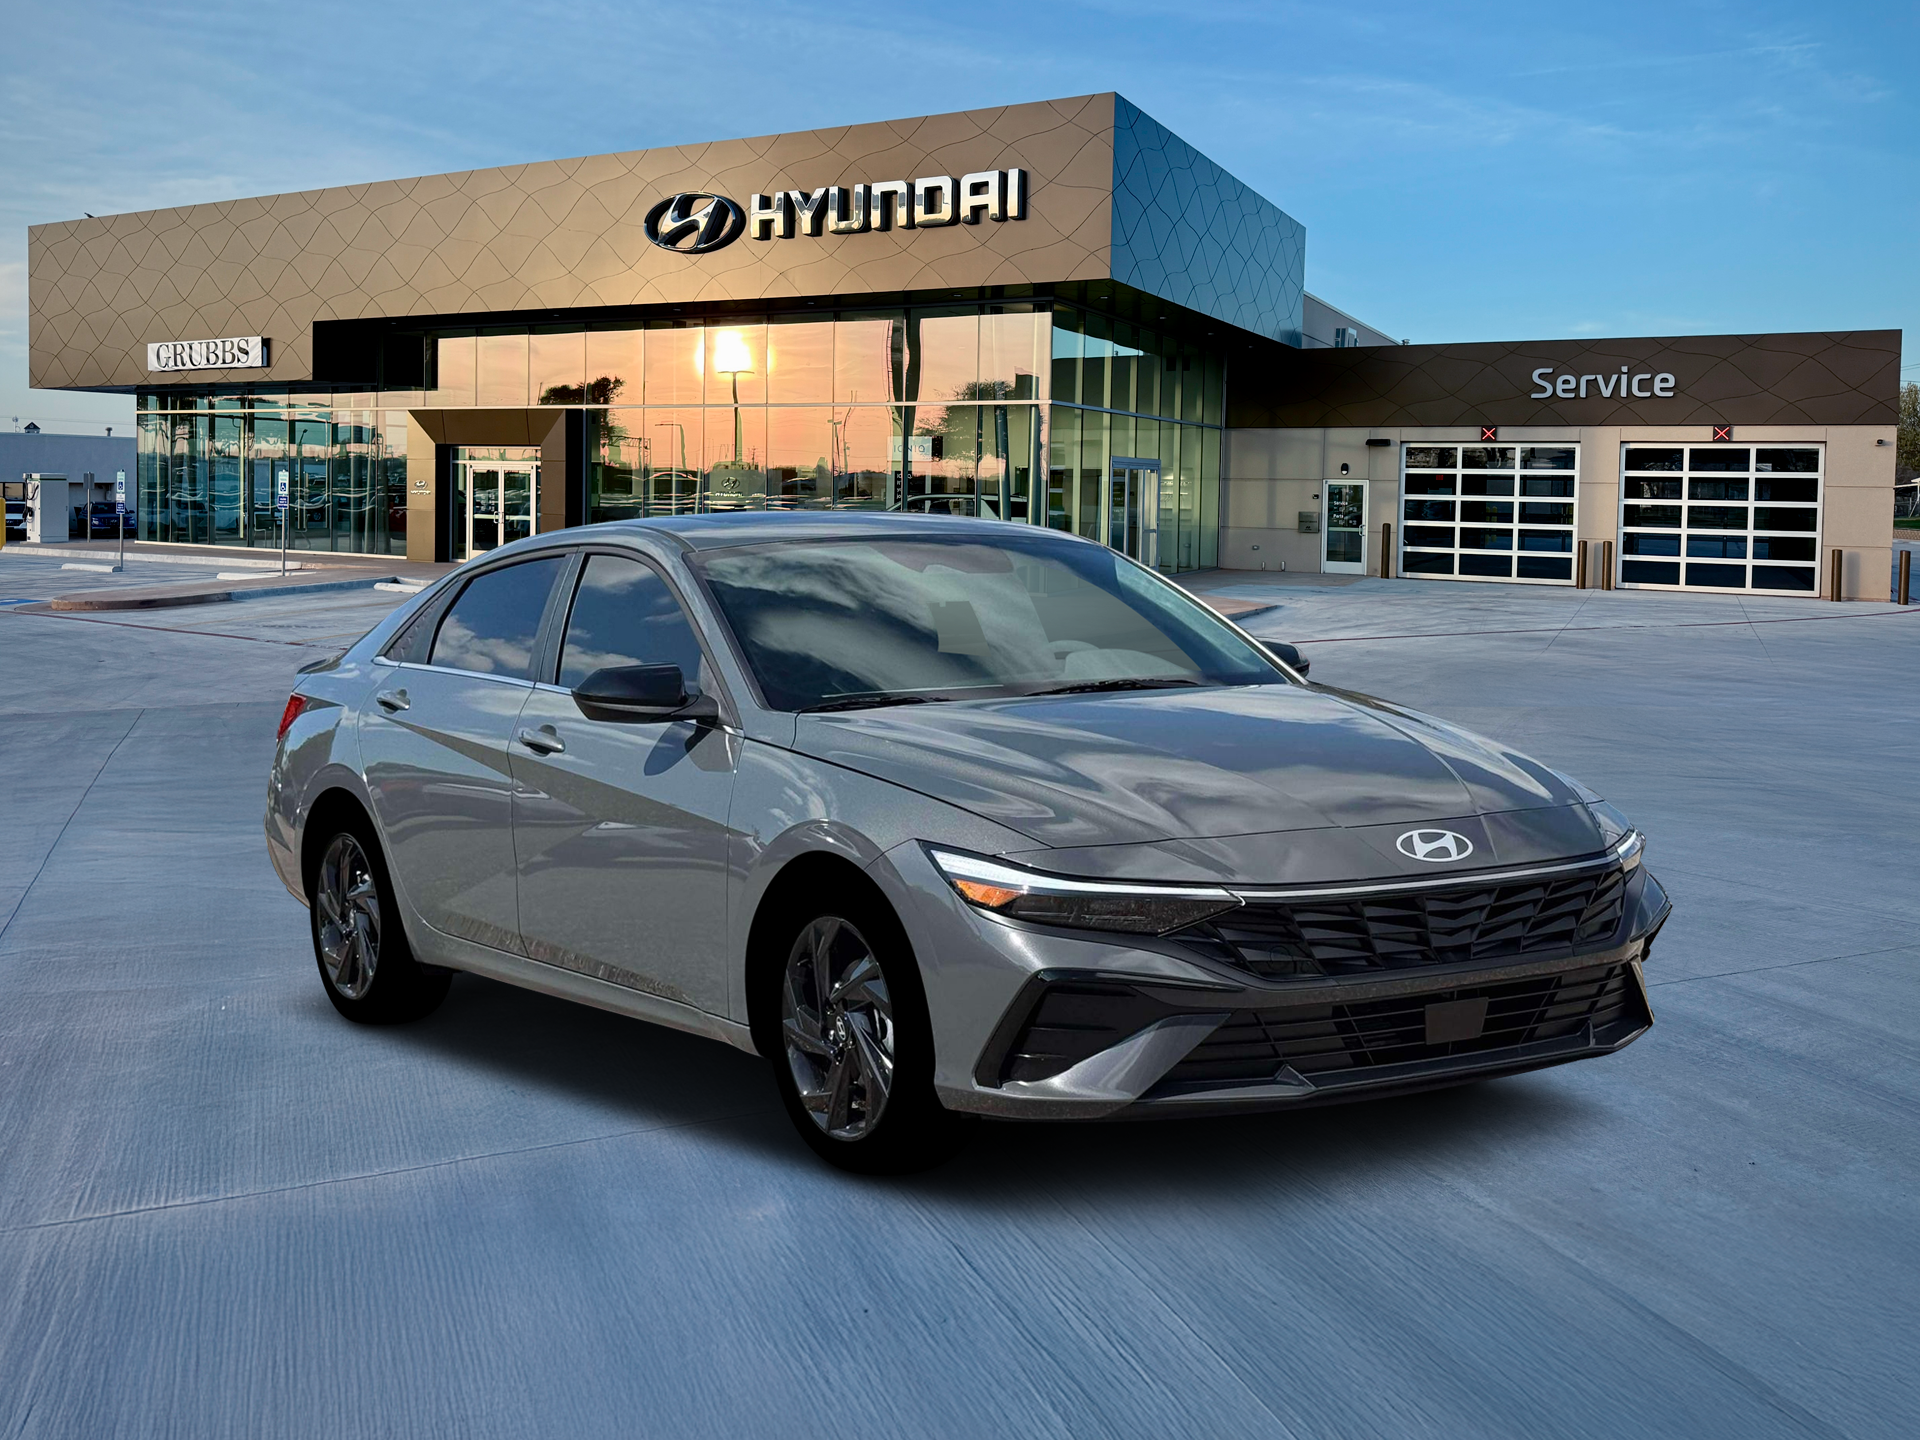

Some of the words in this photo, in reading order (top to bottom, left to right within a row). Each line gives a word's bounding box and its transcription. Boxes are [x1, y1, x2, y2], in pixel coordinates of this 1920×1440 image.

[751, 168, 1024, 239] HYUNDAI
[156, 338, 250, 369] GRUBBS
[1531, 365, 1676, 399] Service
